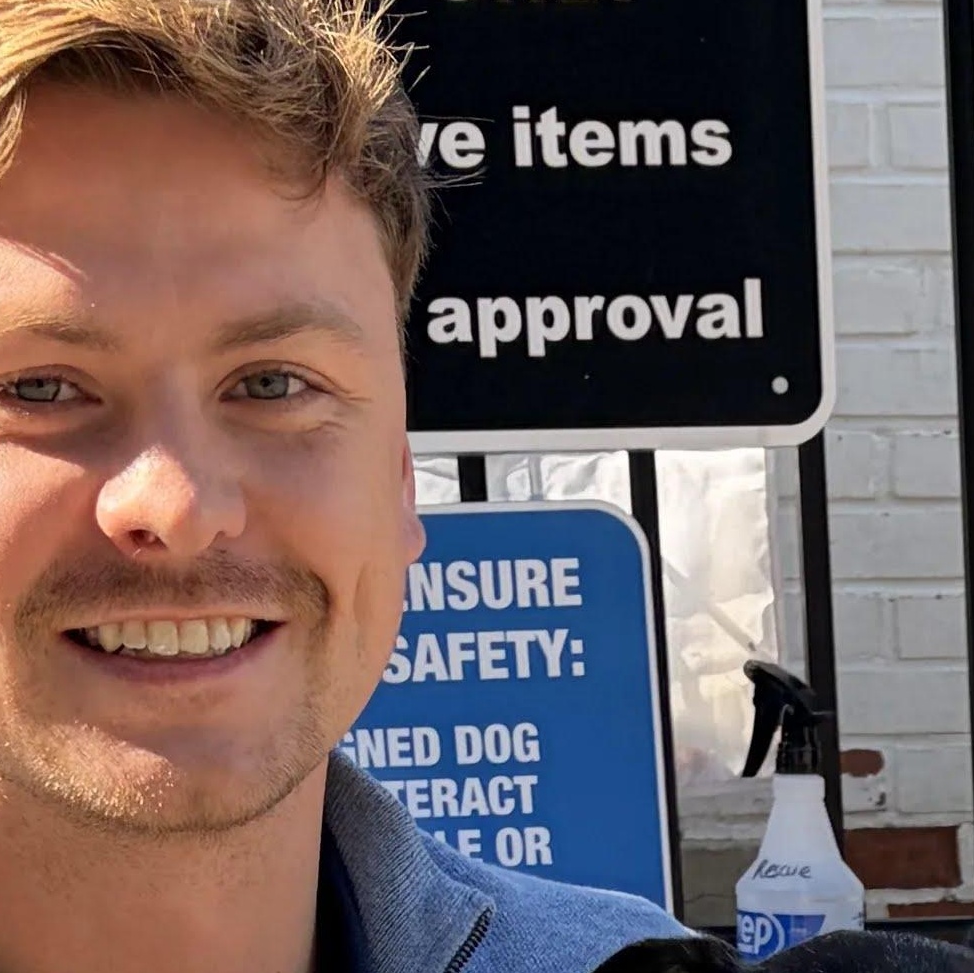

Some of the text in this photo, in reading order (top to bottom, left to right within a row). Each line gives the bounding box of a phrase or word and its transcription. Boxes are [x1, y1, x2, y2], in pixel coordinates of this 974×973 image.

[415, 105, 733, 169] ve items
[426, 277, 764, 358] approval
[403, 557, 583, 612] NSURE
[382, 628, 586, 684] SAFETY:
[454, 722, 541, 766] DOG
[382, 774, 539, 819] TERACT
[495, 826, 553, 868] OR
[737, 913, 774, 955] ep
